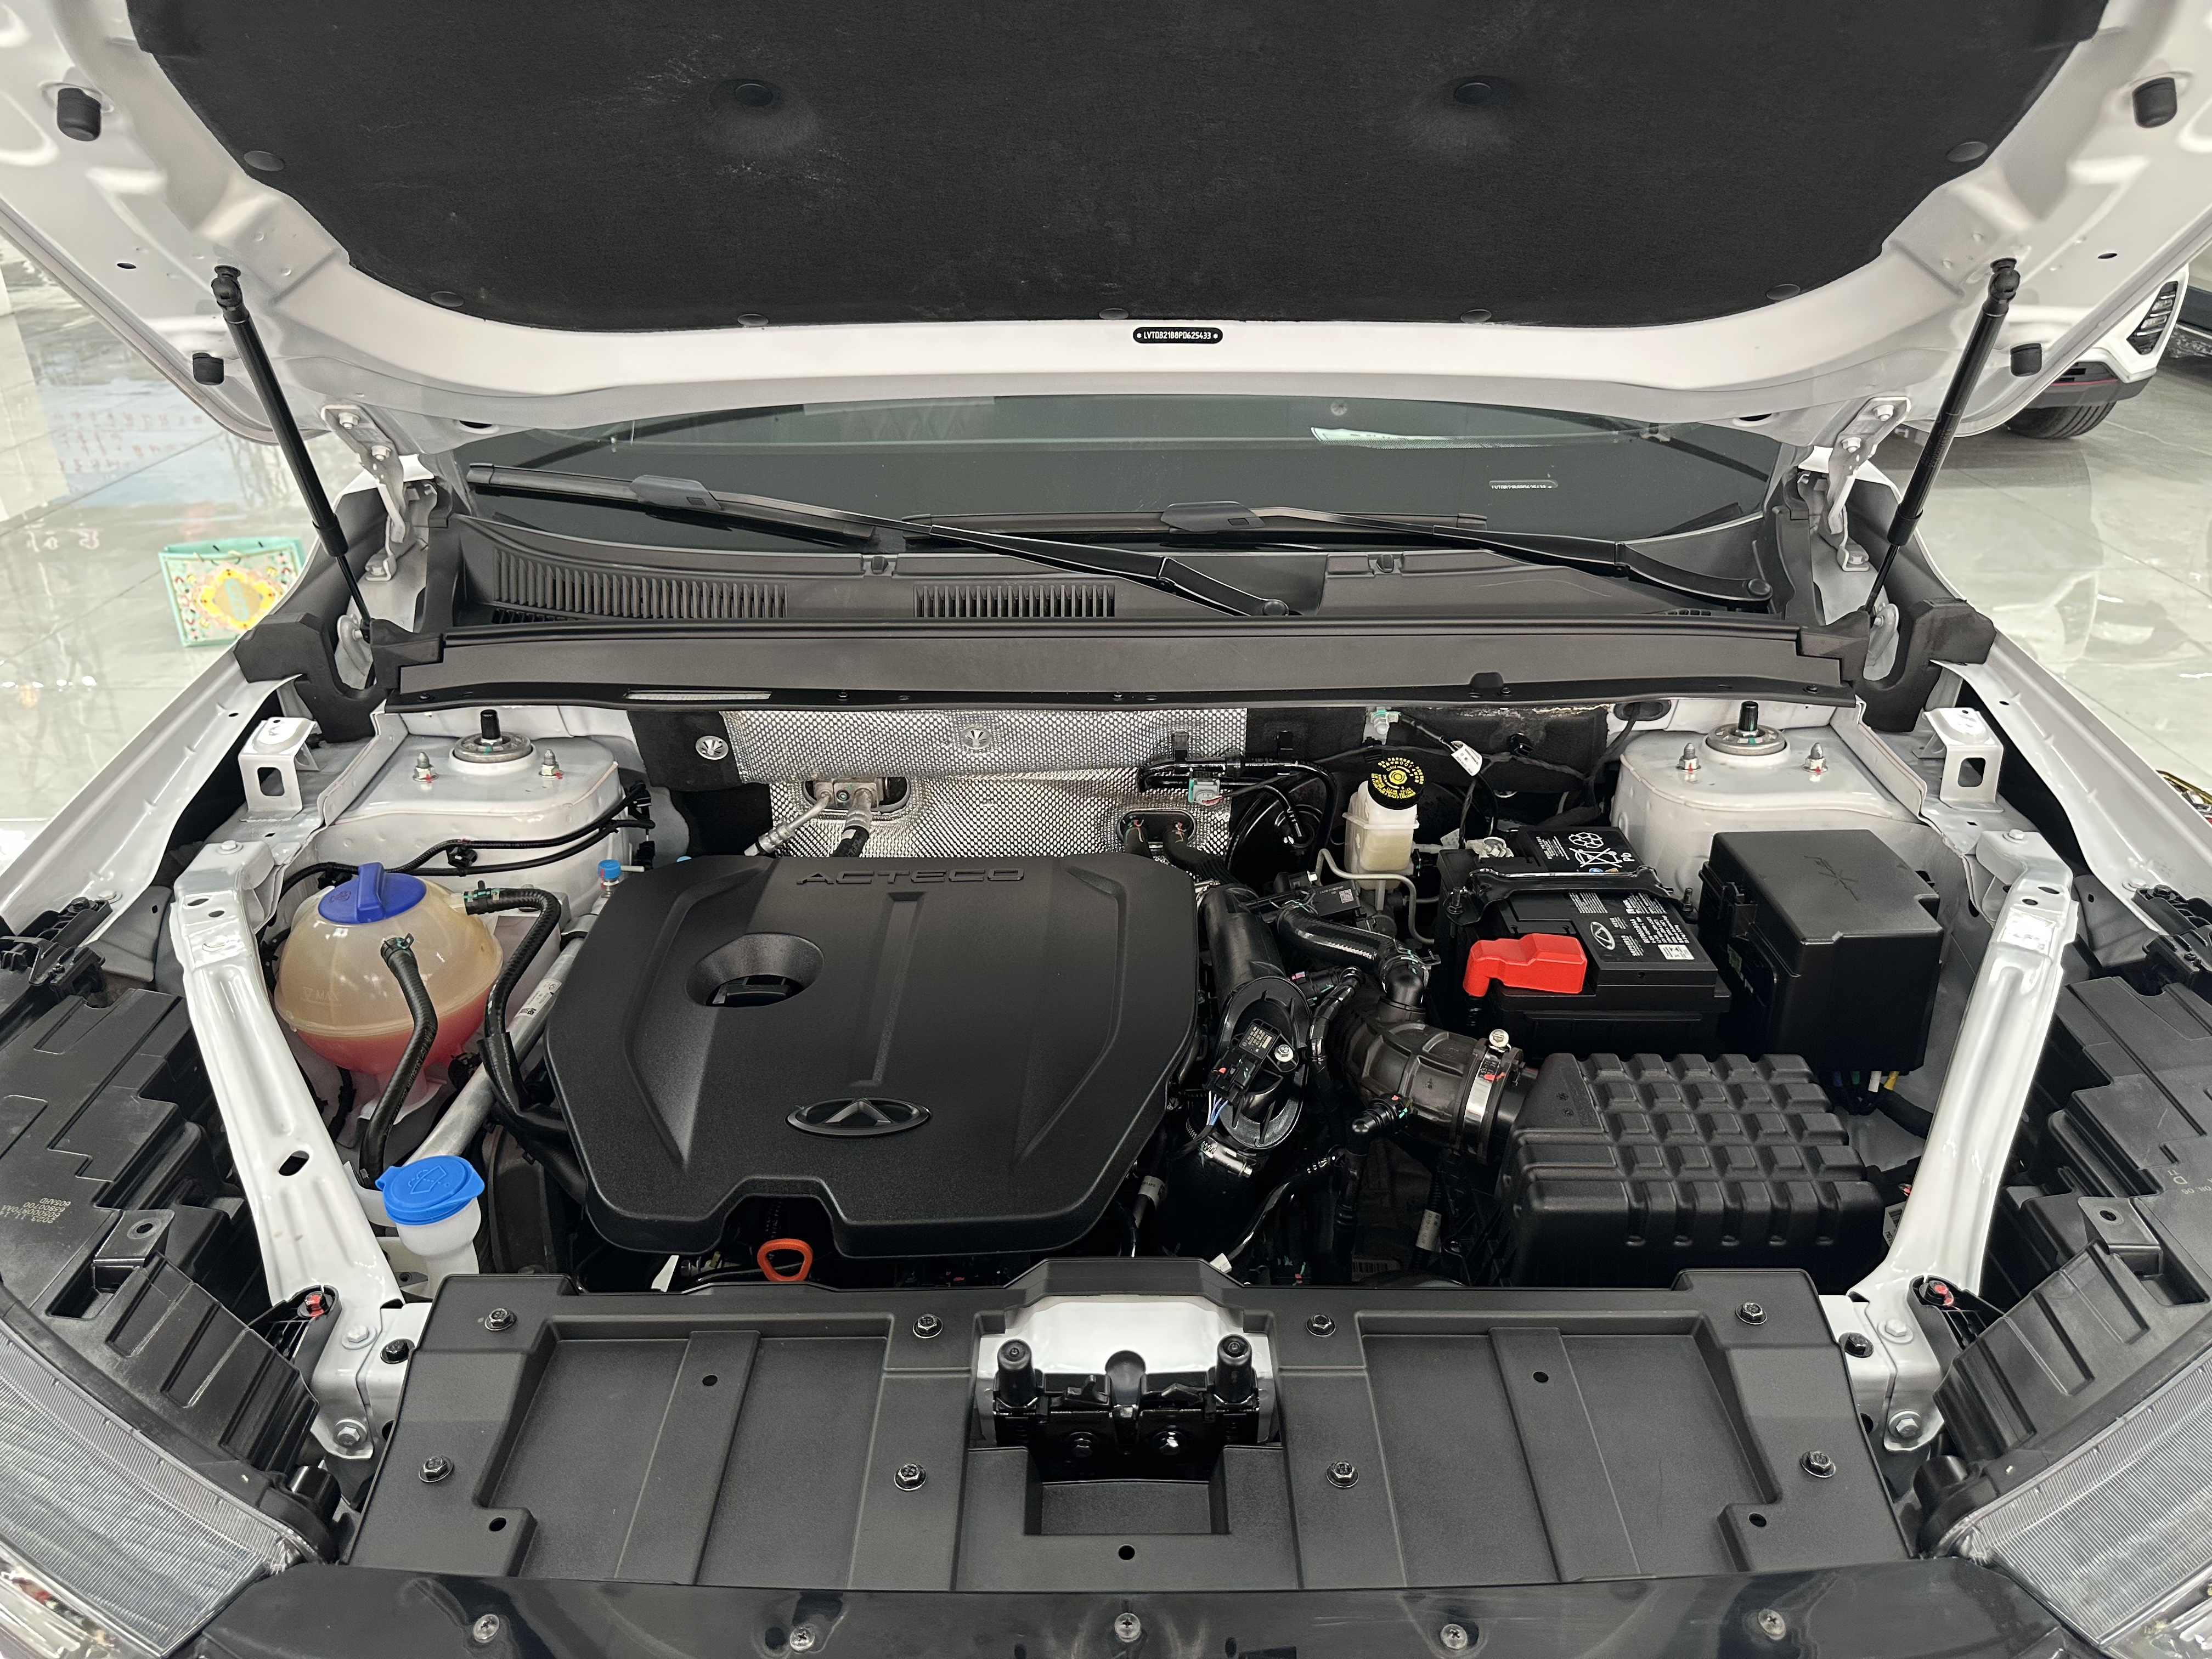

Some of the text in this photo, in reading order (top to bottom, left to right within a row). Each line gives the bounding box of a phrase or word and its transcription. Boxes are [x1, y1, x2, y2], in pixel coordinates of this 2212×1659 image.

[796, 868, 1025, 884] ACTECO
[316, 988, 340, 1001] MAX
[2173, 1176, 2188, 1184] D
